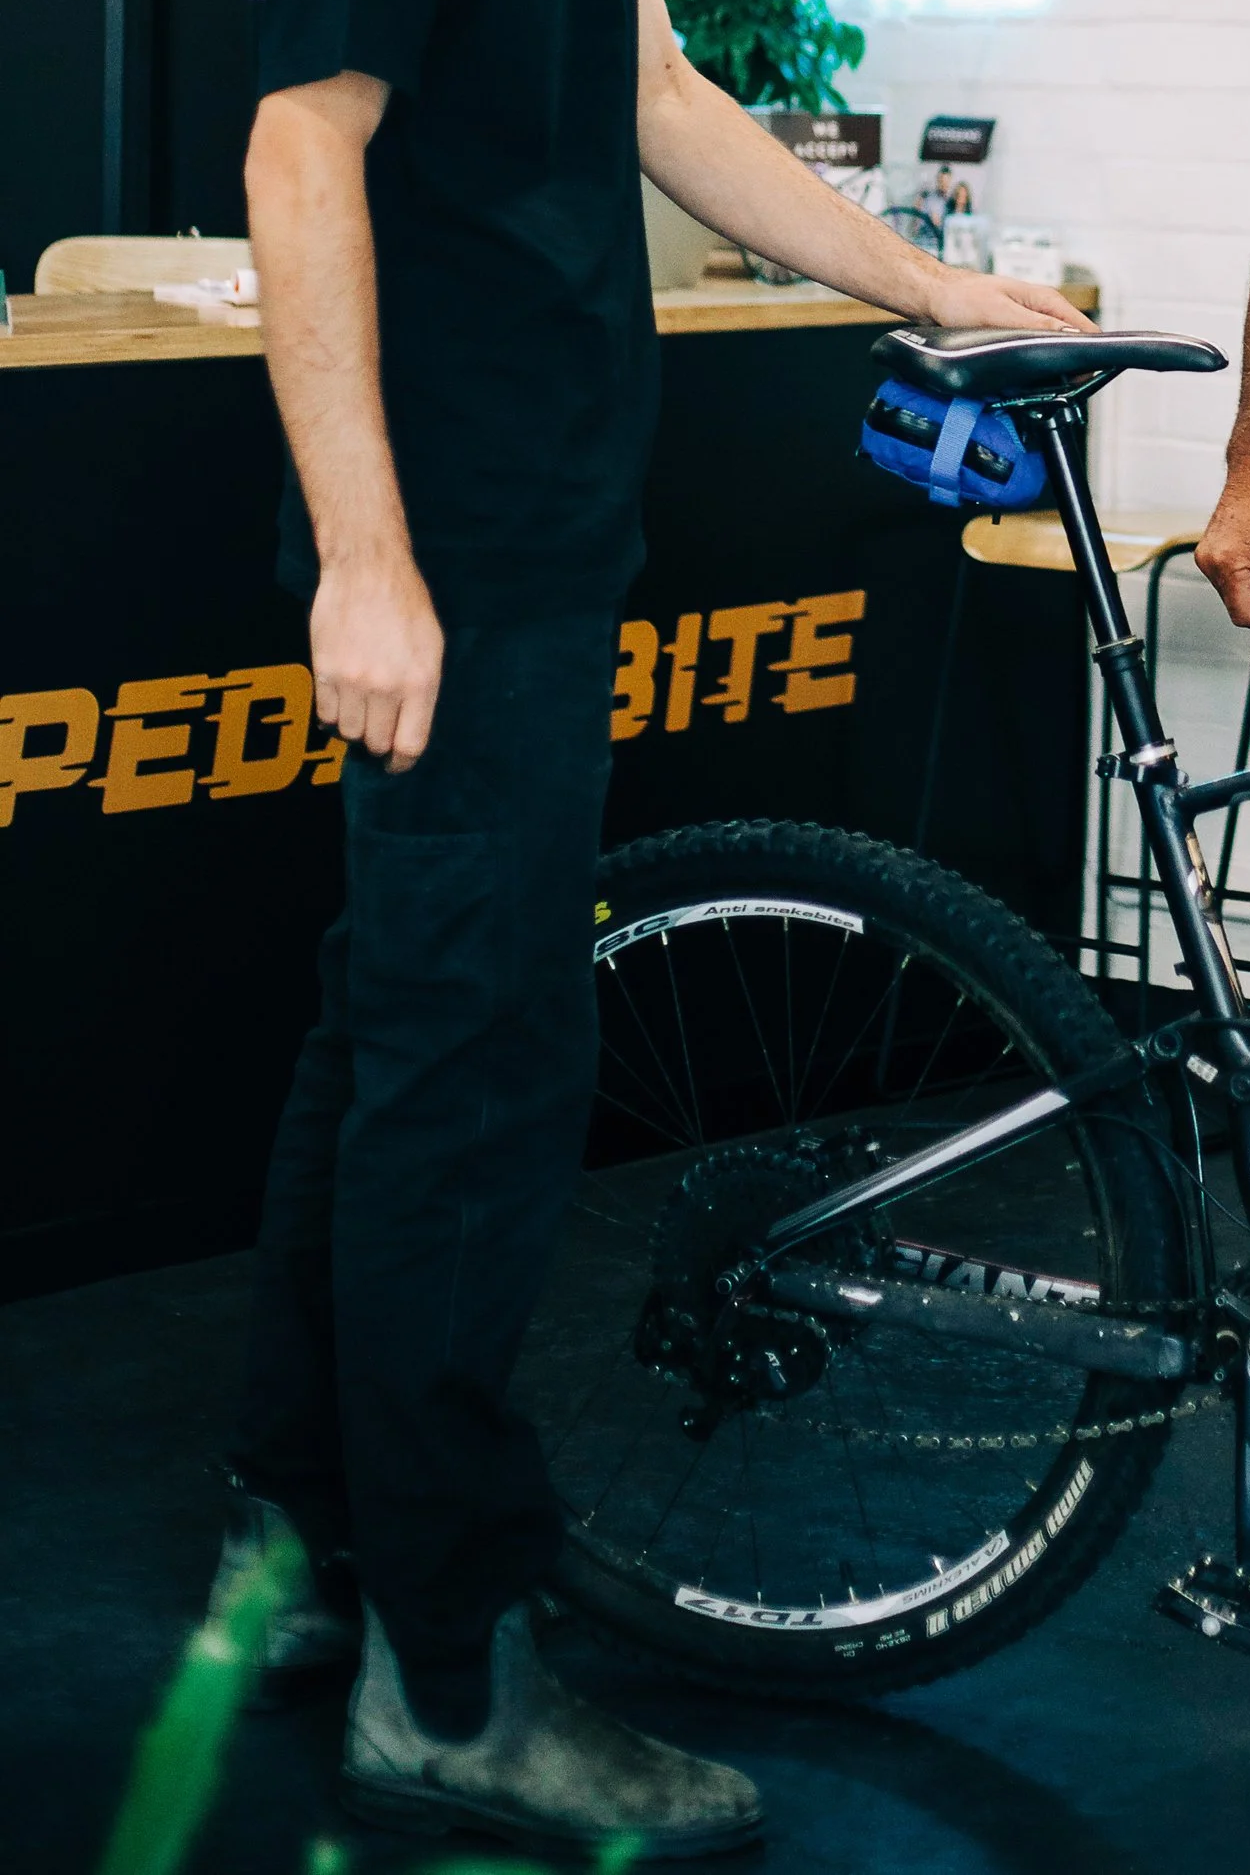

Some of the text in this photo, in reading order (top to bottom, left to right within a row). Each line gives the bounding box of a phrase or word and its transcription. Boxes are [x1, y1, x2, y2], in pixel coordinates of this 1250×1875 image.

[610, 589, 866, 741] BITE
[703, 904, 748, 916] Anti
[754, 905, 855, 929] snakebite
[902, 1556, 981, 1605] ALEXRIMS
[952, 1529, 1048, 1623] ROLLER
[685, 1597, 824, 1627] TD17
